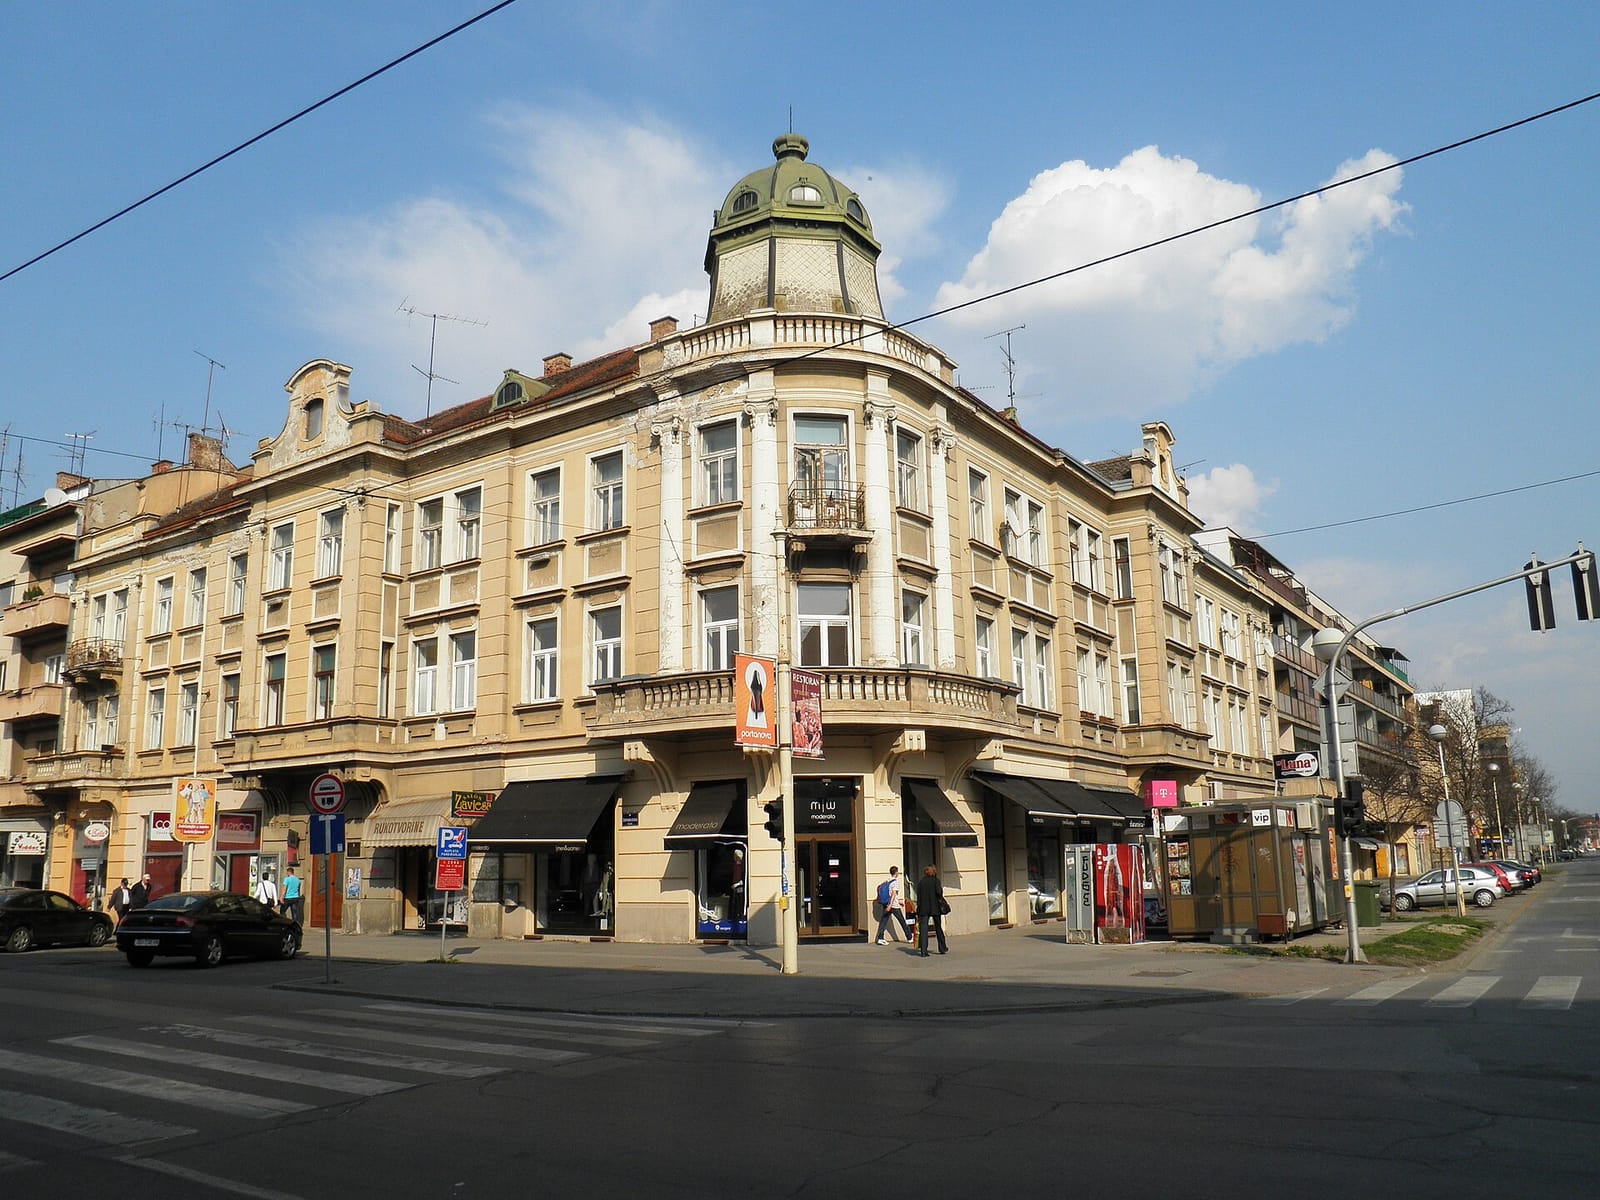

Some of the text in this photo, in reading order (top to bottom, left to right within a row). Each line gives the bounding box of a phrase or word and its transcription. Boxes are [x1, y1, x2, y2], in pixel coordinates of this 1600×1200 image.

[793, 673, 820, 687] RESTORAN
[741, 729, 772, 739] portanova
[1253, 812, 1270, 824] vip
[373, 820, 425, 834] RUKOTVORINE
[675, 821, 720, 830] moderato
[440, 829, 455, 848] P
